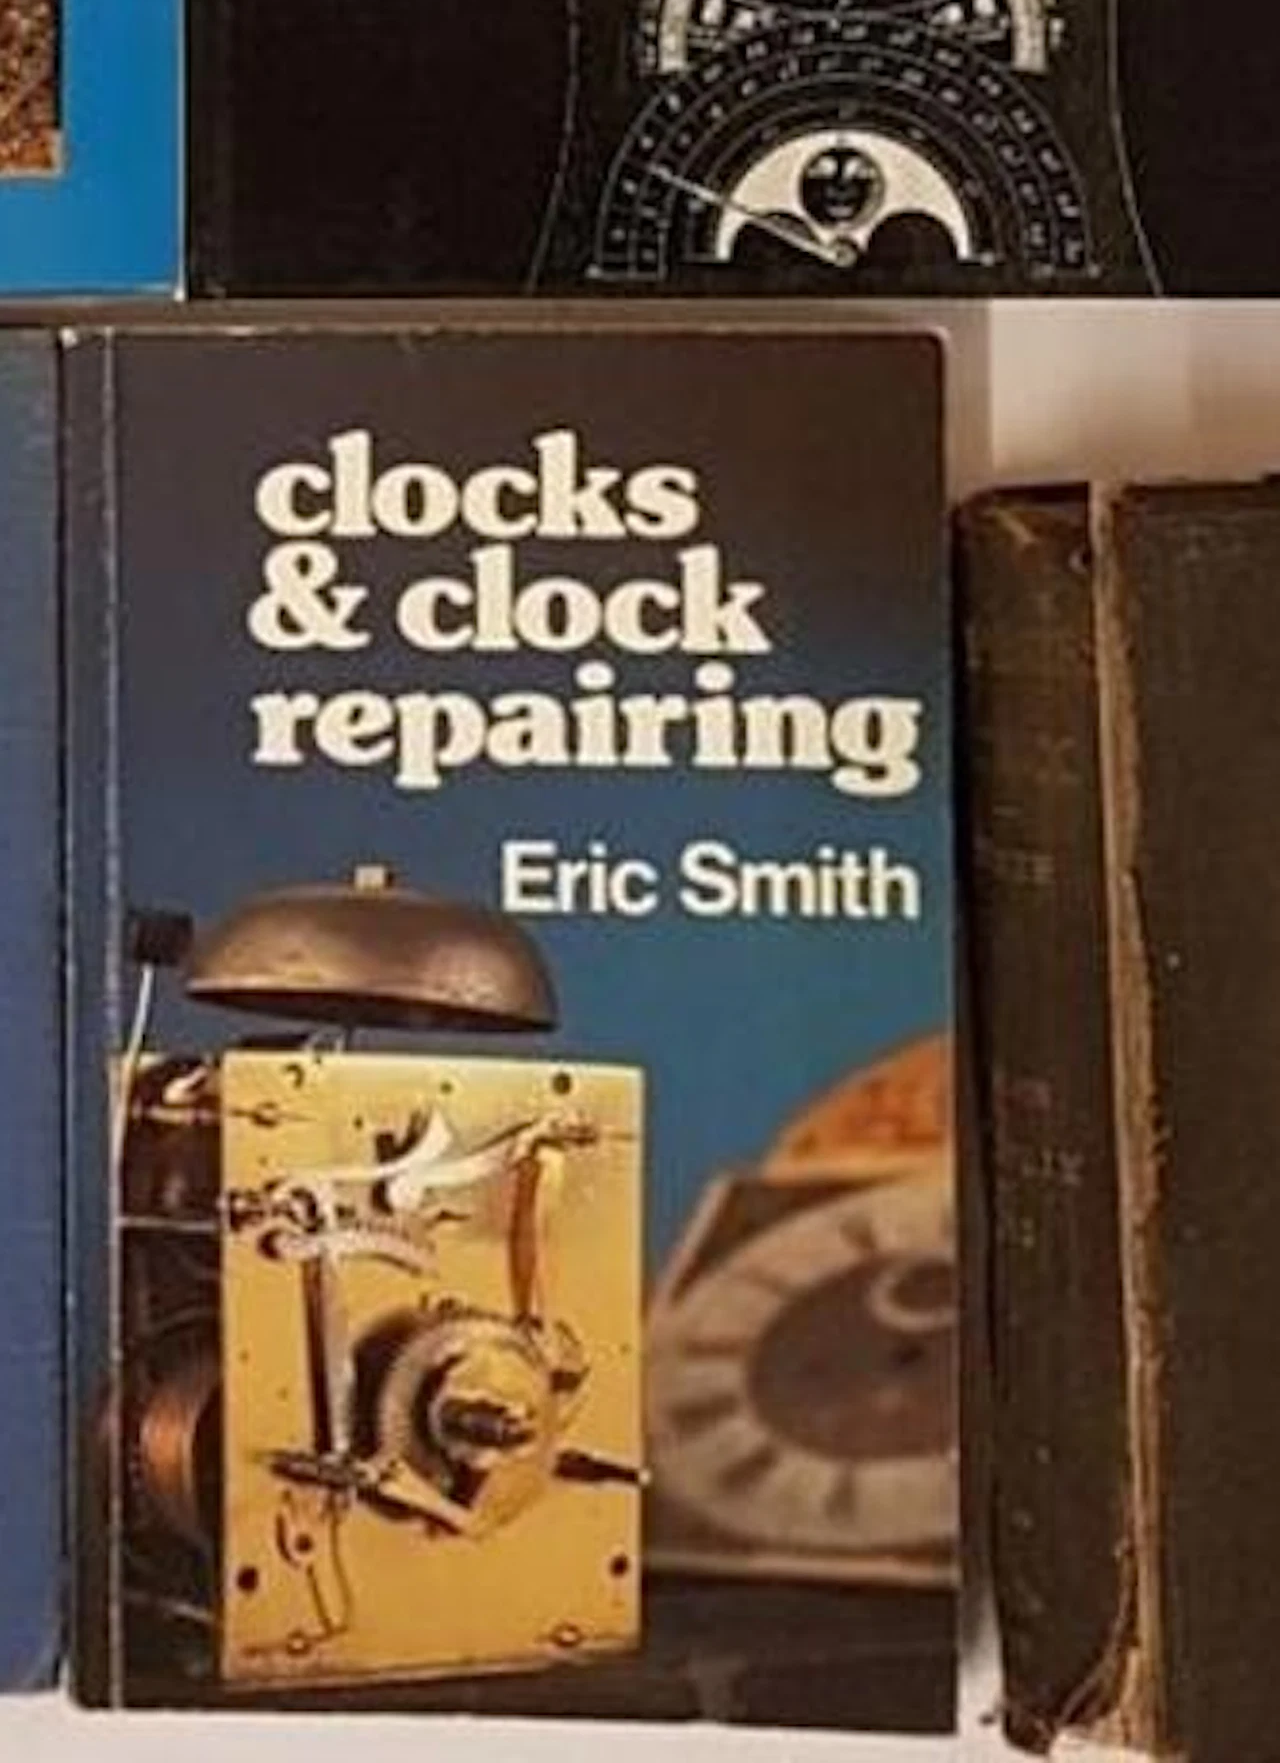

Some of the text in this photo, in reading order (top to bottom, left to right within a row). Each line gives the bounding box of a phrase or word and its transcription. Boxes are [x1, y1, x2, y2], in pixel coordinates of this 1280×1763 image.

[255, 429, 700, 539] clocks
[248, 540, 772, 655] & clock
[251, 661, 922, 796] repairing
[500, 841, 920, 920] Eric Smith
